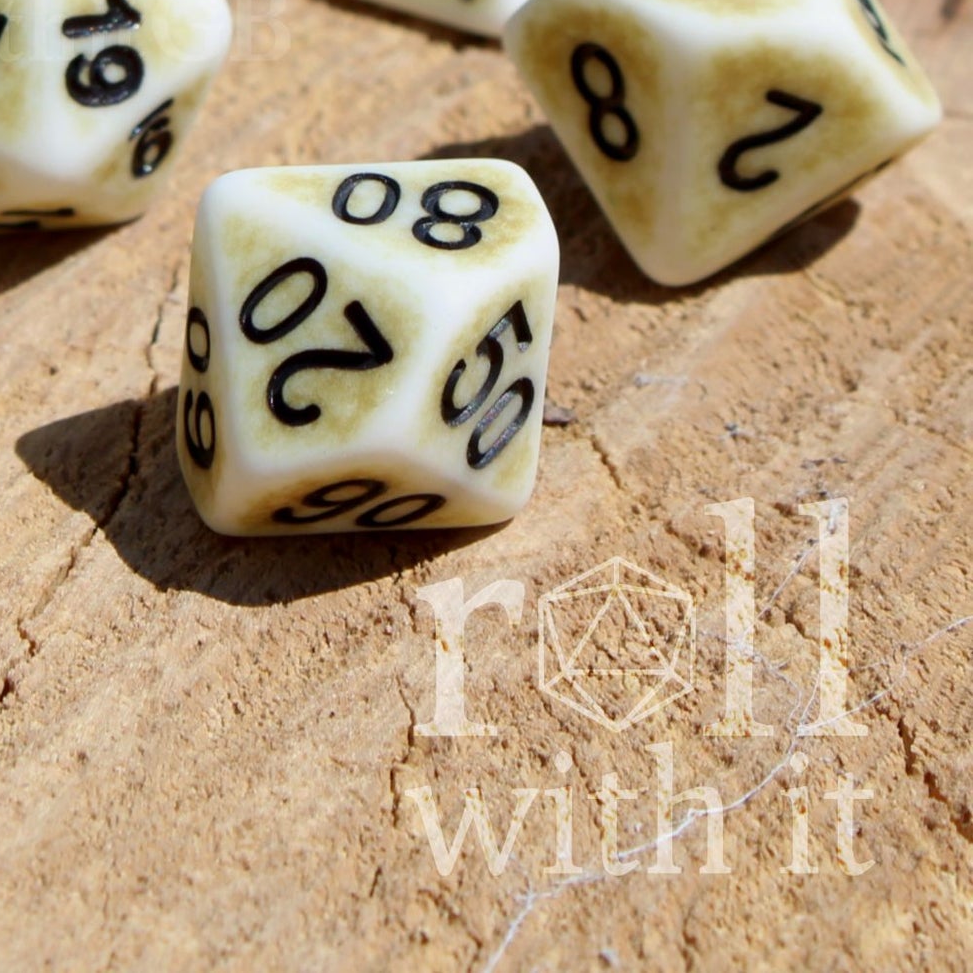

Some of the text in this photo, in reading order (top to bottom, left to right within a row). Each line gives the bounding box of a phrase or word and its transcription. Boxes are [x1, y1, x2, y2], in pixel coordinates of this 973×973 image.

[569, 40, 640, 163] 8
[332, 173, 500, 251] 80
[238, 256, 395, 428] 20
[440, 299, 535, 470] 50
